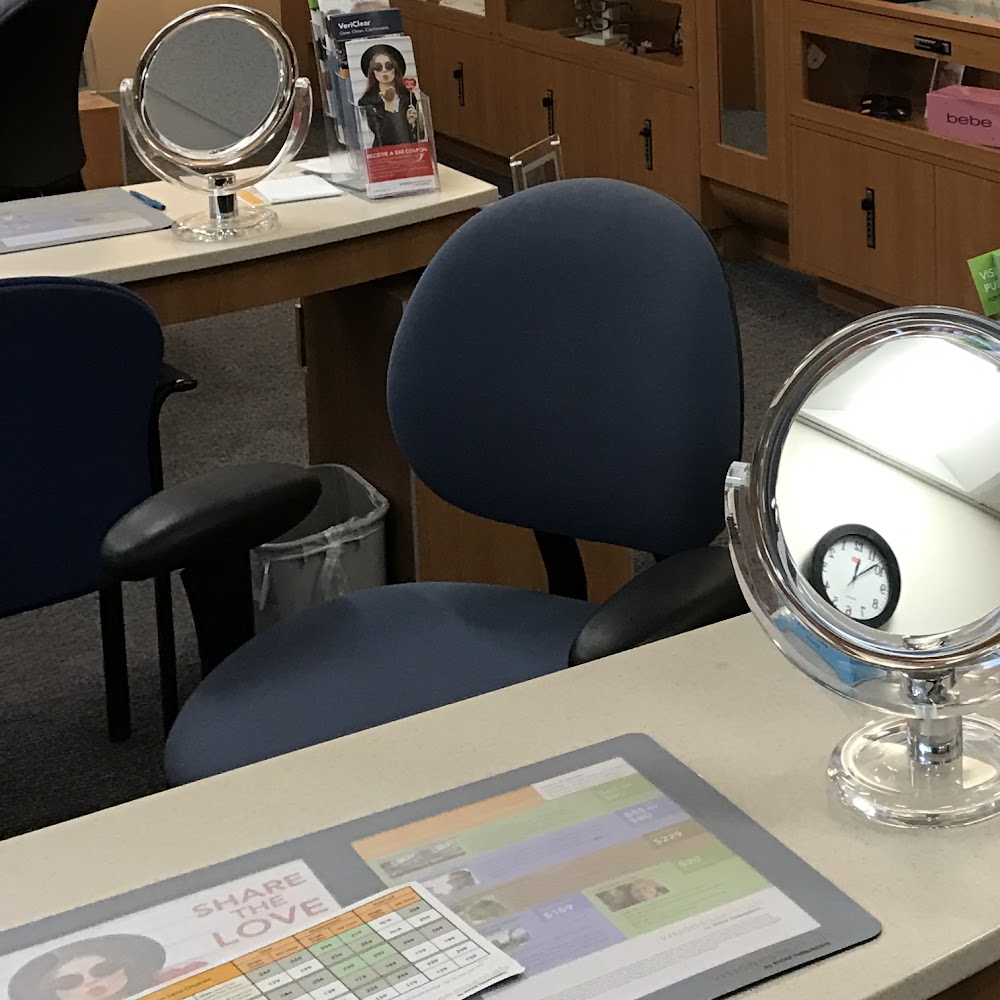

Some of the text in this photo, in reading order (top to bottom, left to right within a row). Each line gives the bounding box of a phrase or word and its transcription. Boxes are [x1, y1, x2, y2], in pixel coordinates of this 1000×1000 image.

[338, 20, 371, 29] VeriClear
[947, 112, 992, 128] bebe
[192, 872, 308, 918] SHARE
[230, 894, 288, 919] THE
[212, 897, 328, 948] LOVE
